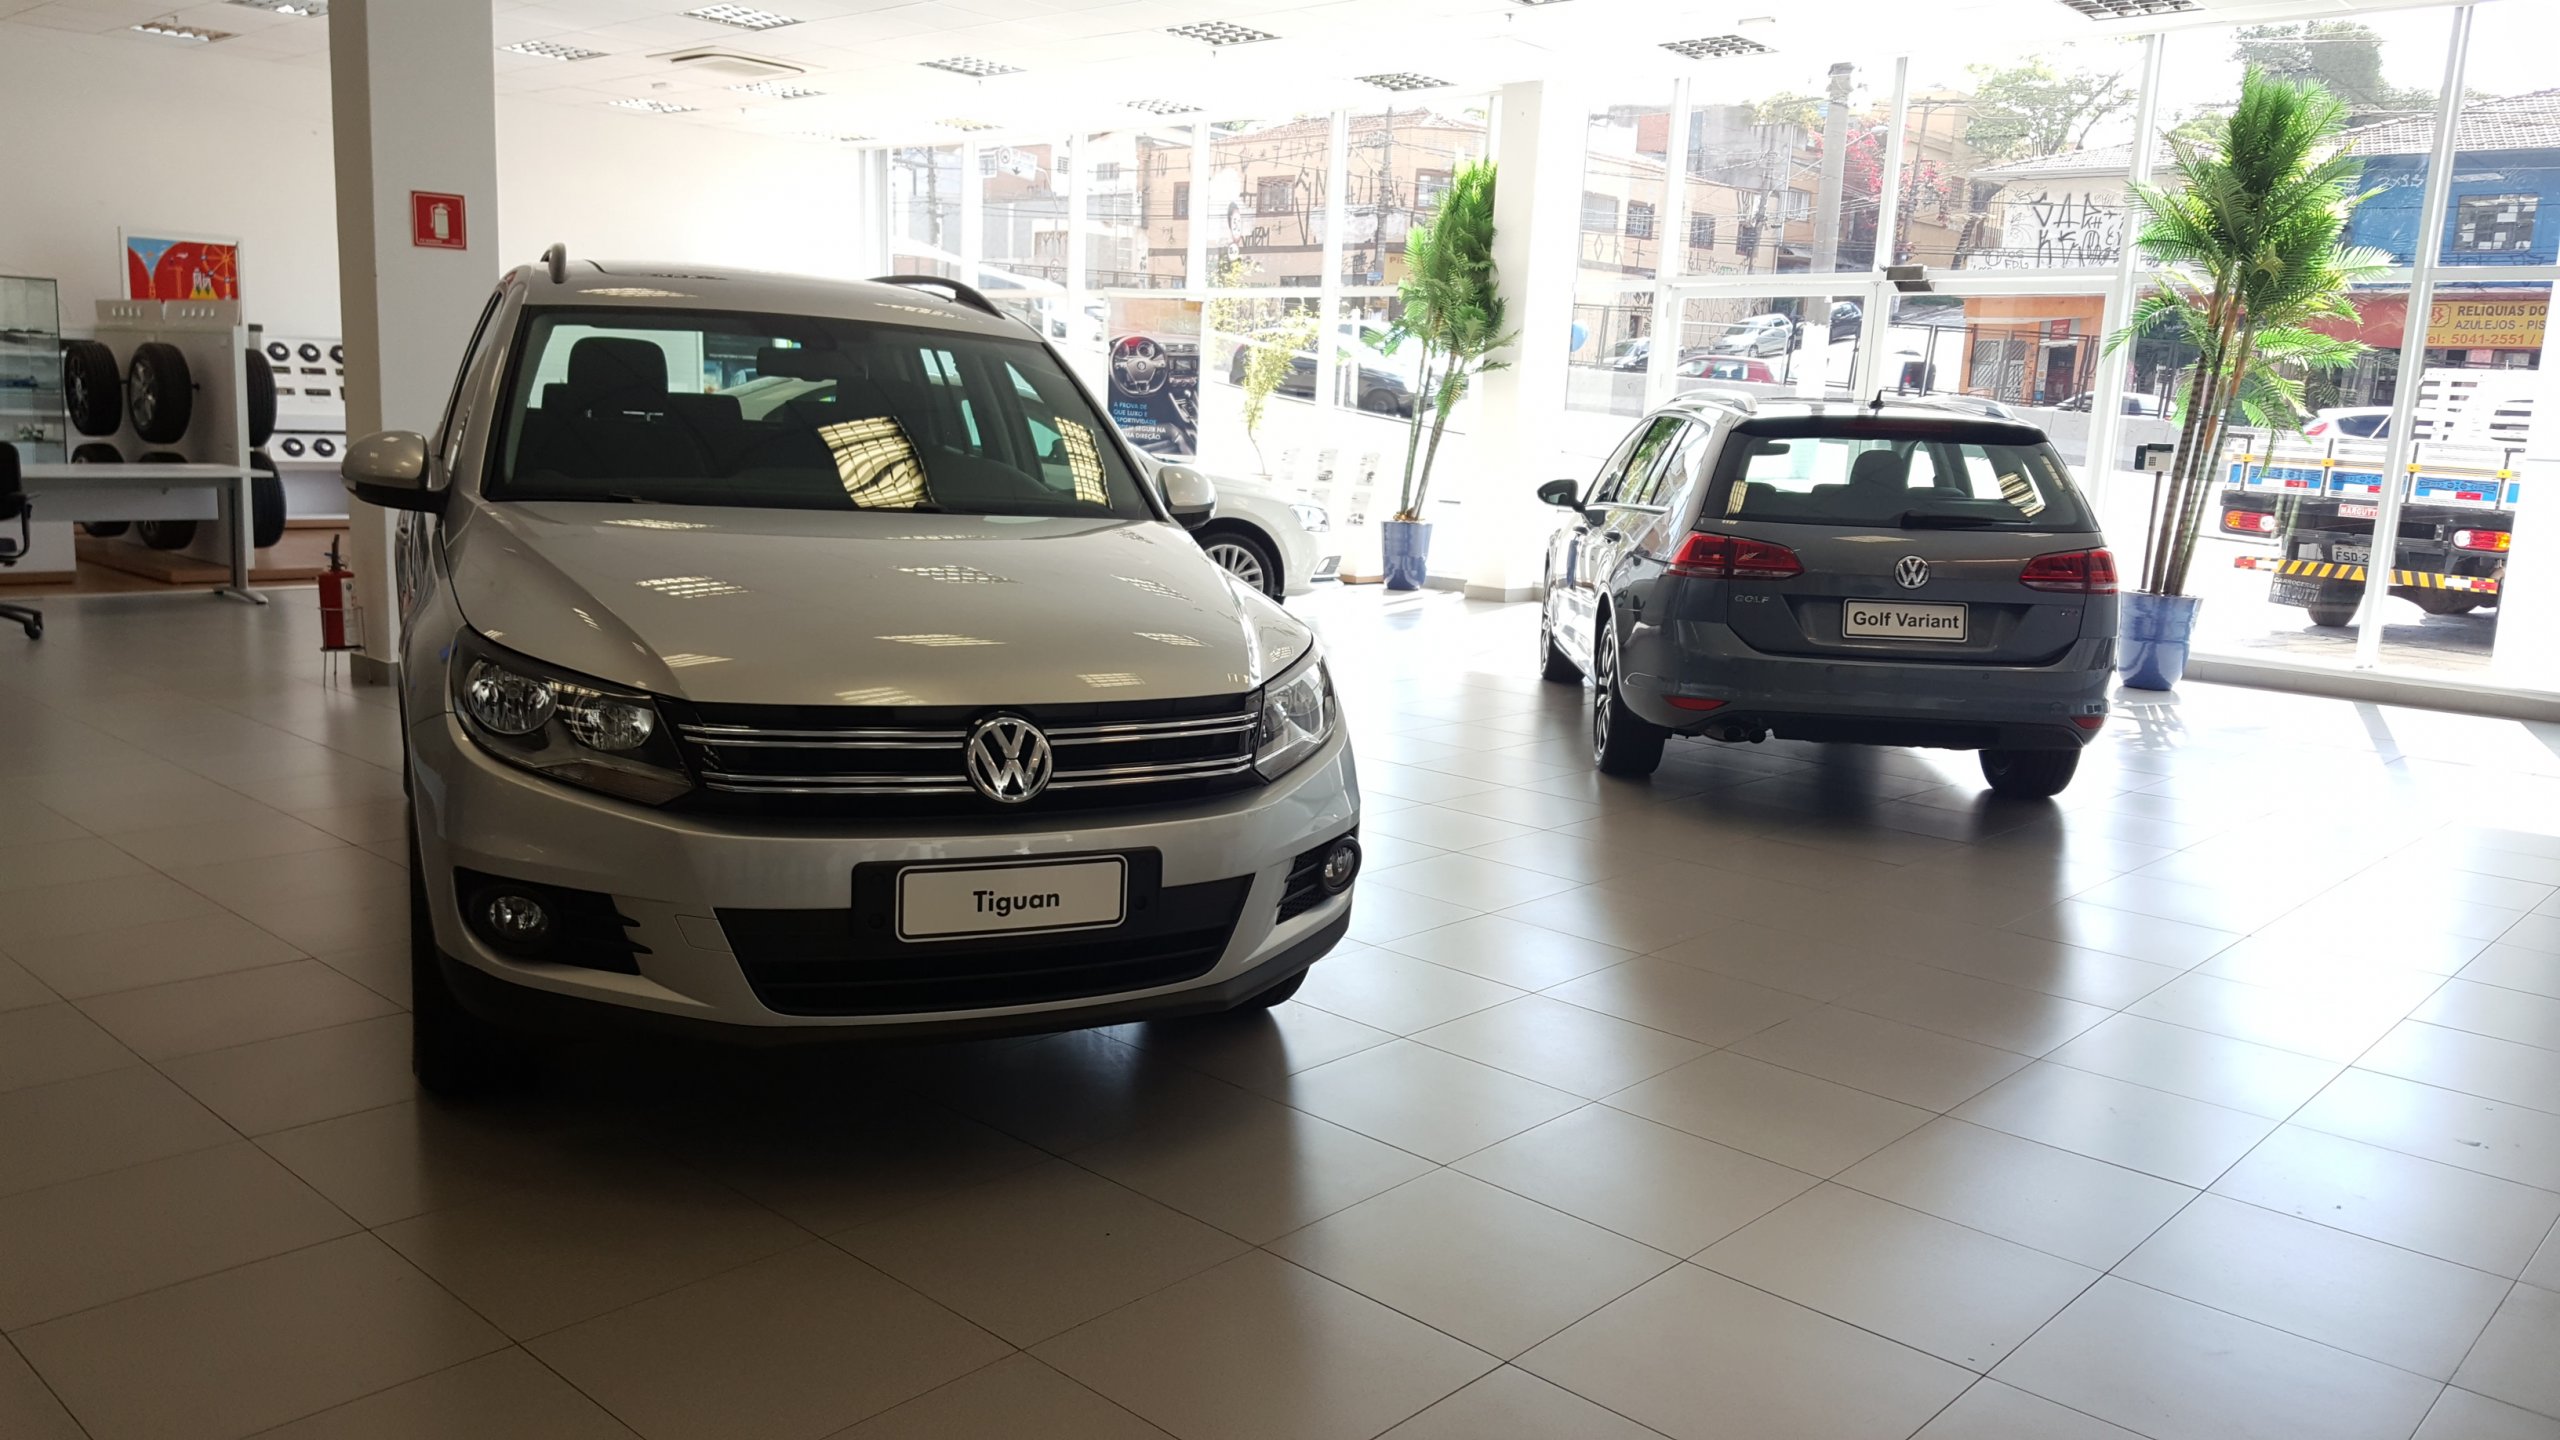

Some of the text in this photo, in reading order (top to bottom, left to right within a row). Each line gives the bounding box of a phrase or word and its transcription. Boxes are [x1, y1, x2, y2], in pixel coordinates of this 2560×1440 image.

[2455, 320, 2516, 330] AZULEJOS
[2424, 333, 2445, 344] el:
[2450, 334, 2525, 344] 5041-2551
[1135, 432, 1161, 440] DIREÇÃO
[1734, 594, 1770, 603] GOLF
[1852, 611, 1959, 629] Golf Variant
[972, 890, 1060, 917] Tiguan
